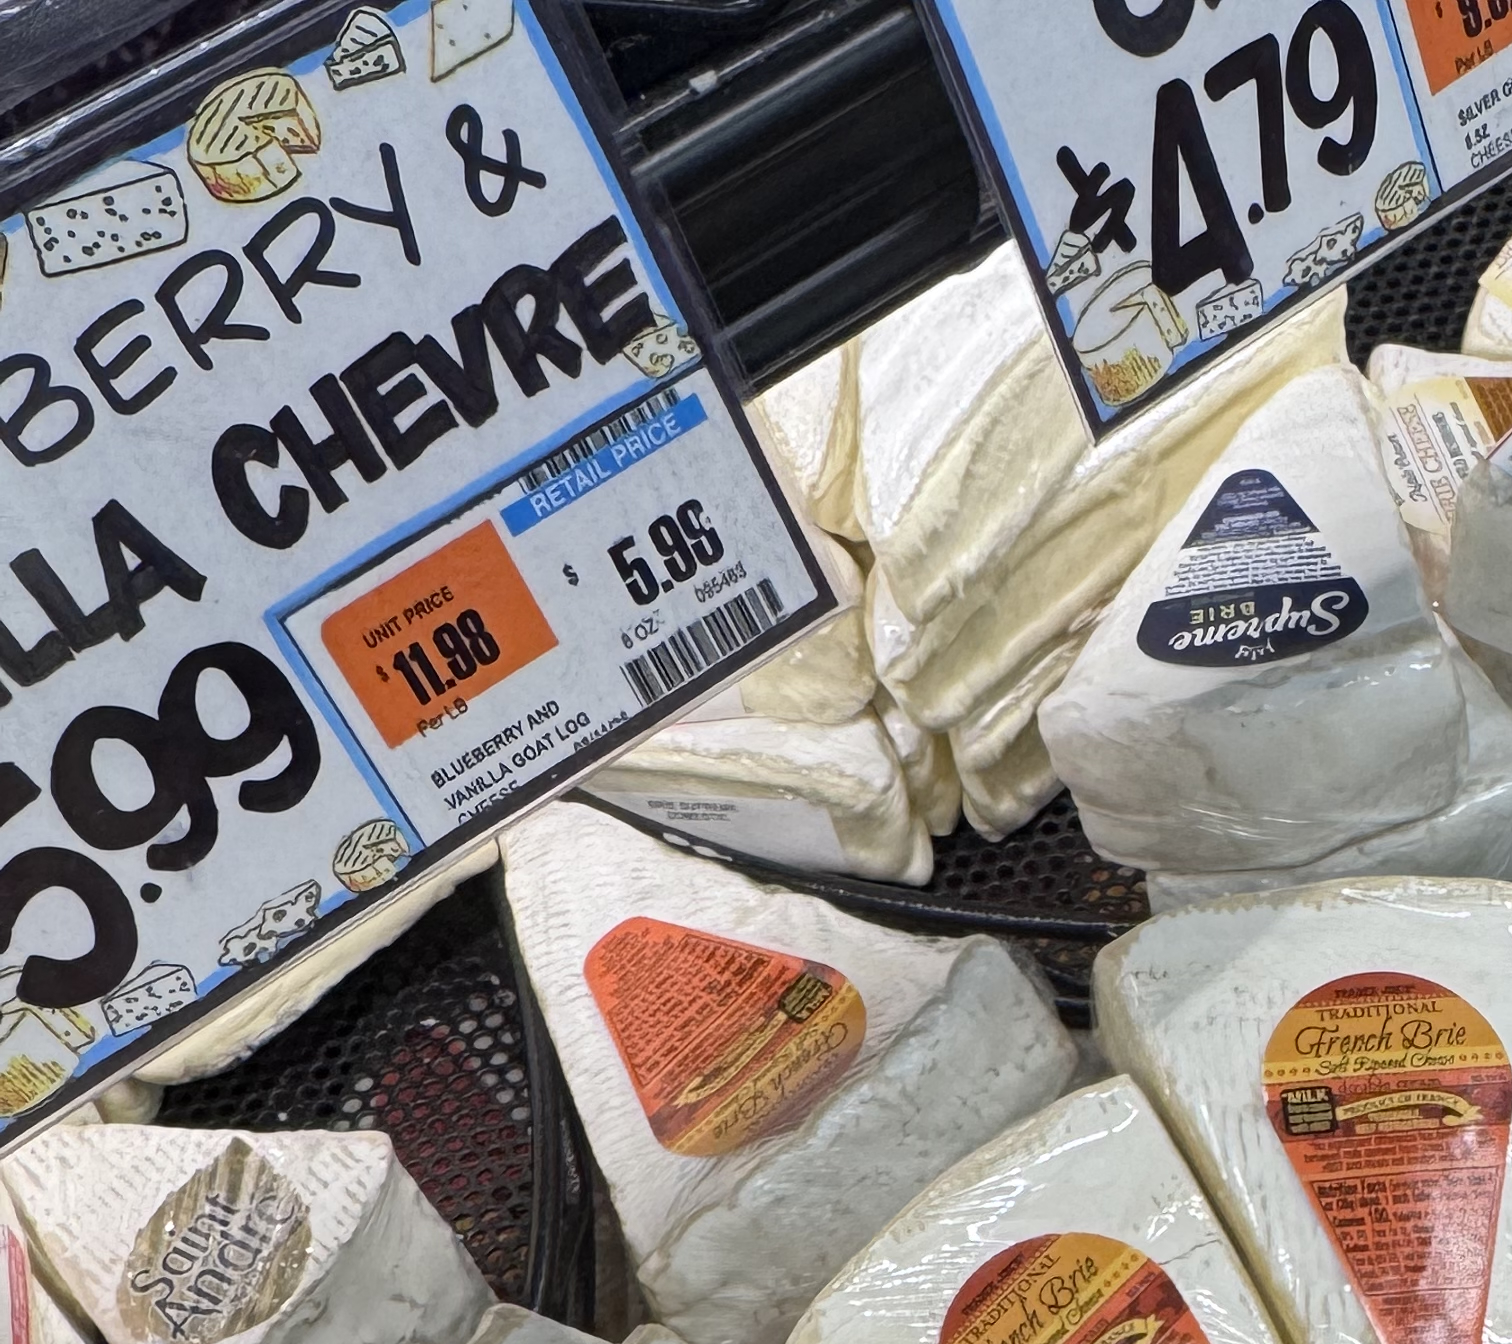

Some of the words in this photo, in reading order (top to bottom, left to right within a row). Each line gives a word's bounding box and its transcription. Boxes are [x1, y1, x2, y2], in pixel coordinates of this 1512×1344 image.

[0, 143, 421, 467] BERRY
[446, 104, 546, 217] &
[0, 499, 208, 690] LLA
[212, 215, 654, 550] CHEVRE
[530, 459, 610, 517] RETAIL
[611, 413, 685, 467] PRICE
[607, 499, 724, 605] 5.99
[363, 616, 401, 648] UNIT
[403, 586, 454, 625] PRICE
[393, 609, 500, 705] 11.98
[1168, 591, 1349, 650] Supreme
[431, 721, 523, 789] BLUEBERRY
[527, 701, 559, 730] AND
[443, 697, 468, 719] LB
[444, 763, 513, 809] VANILLA
[512, 733, 554, 767] GOAT
[555, 712, 590, 741] LOG
[1295, 1016, 1392, 1058] French
[1401, 1020, 1466, 1049] Brie
[1315, 1001, 1442, 1021] TRADITIONAL
[131, 1194, 240, 1309] Saint
[1039, 1257, 1098, 1315] Brie
